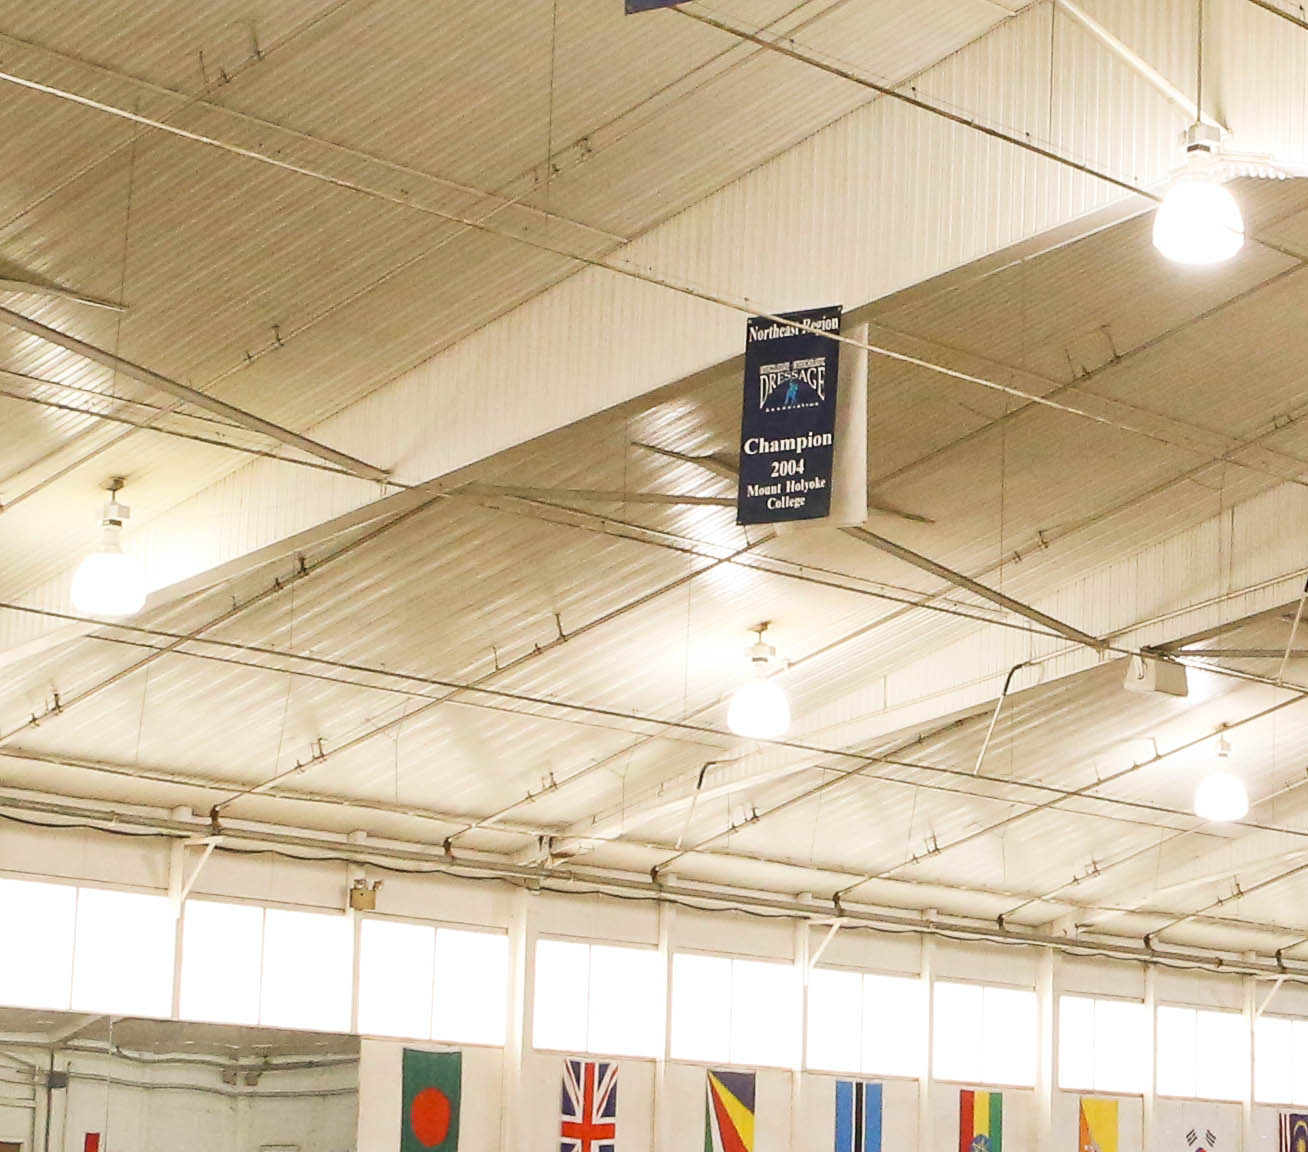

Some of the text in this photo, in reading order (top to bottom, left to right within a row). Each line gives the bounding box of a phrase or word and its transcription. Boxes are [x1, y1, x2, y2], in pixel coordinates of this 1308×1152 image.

[749, 316, 839, 342] Northeast Region
[760, 367, 825, 409] DRESSAGE
[744, 432, 832, 455] Champion
[770, 458, 805, 478] 2004
[747, 477, 826, 497] Mount Holyoke
[767, 497, 806, 510] College
